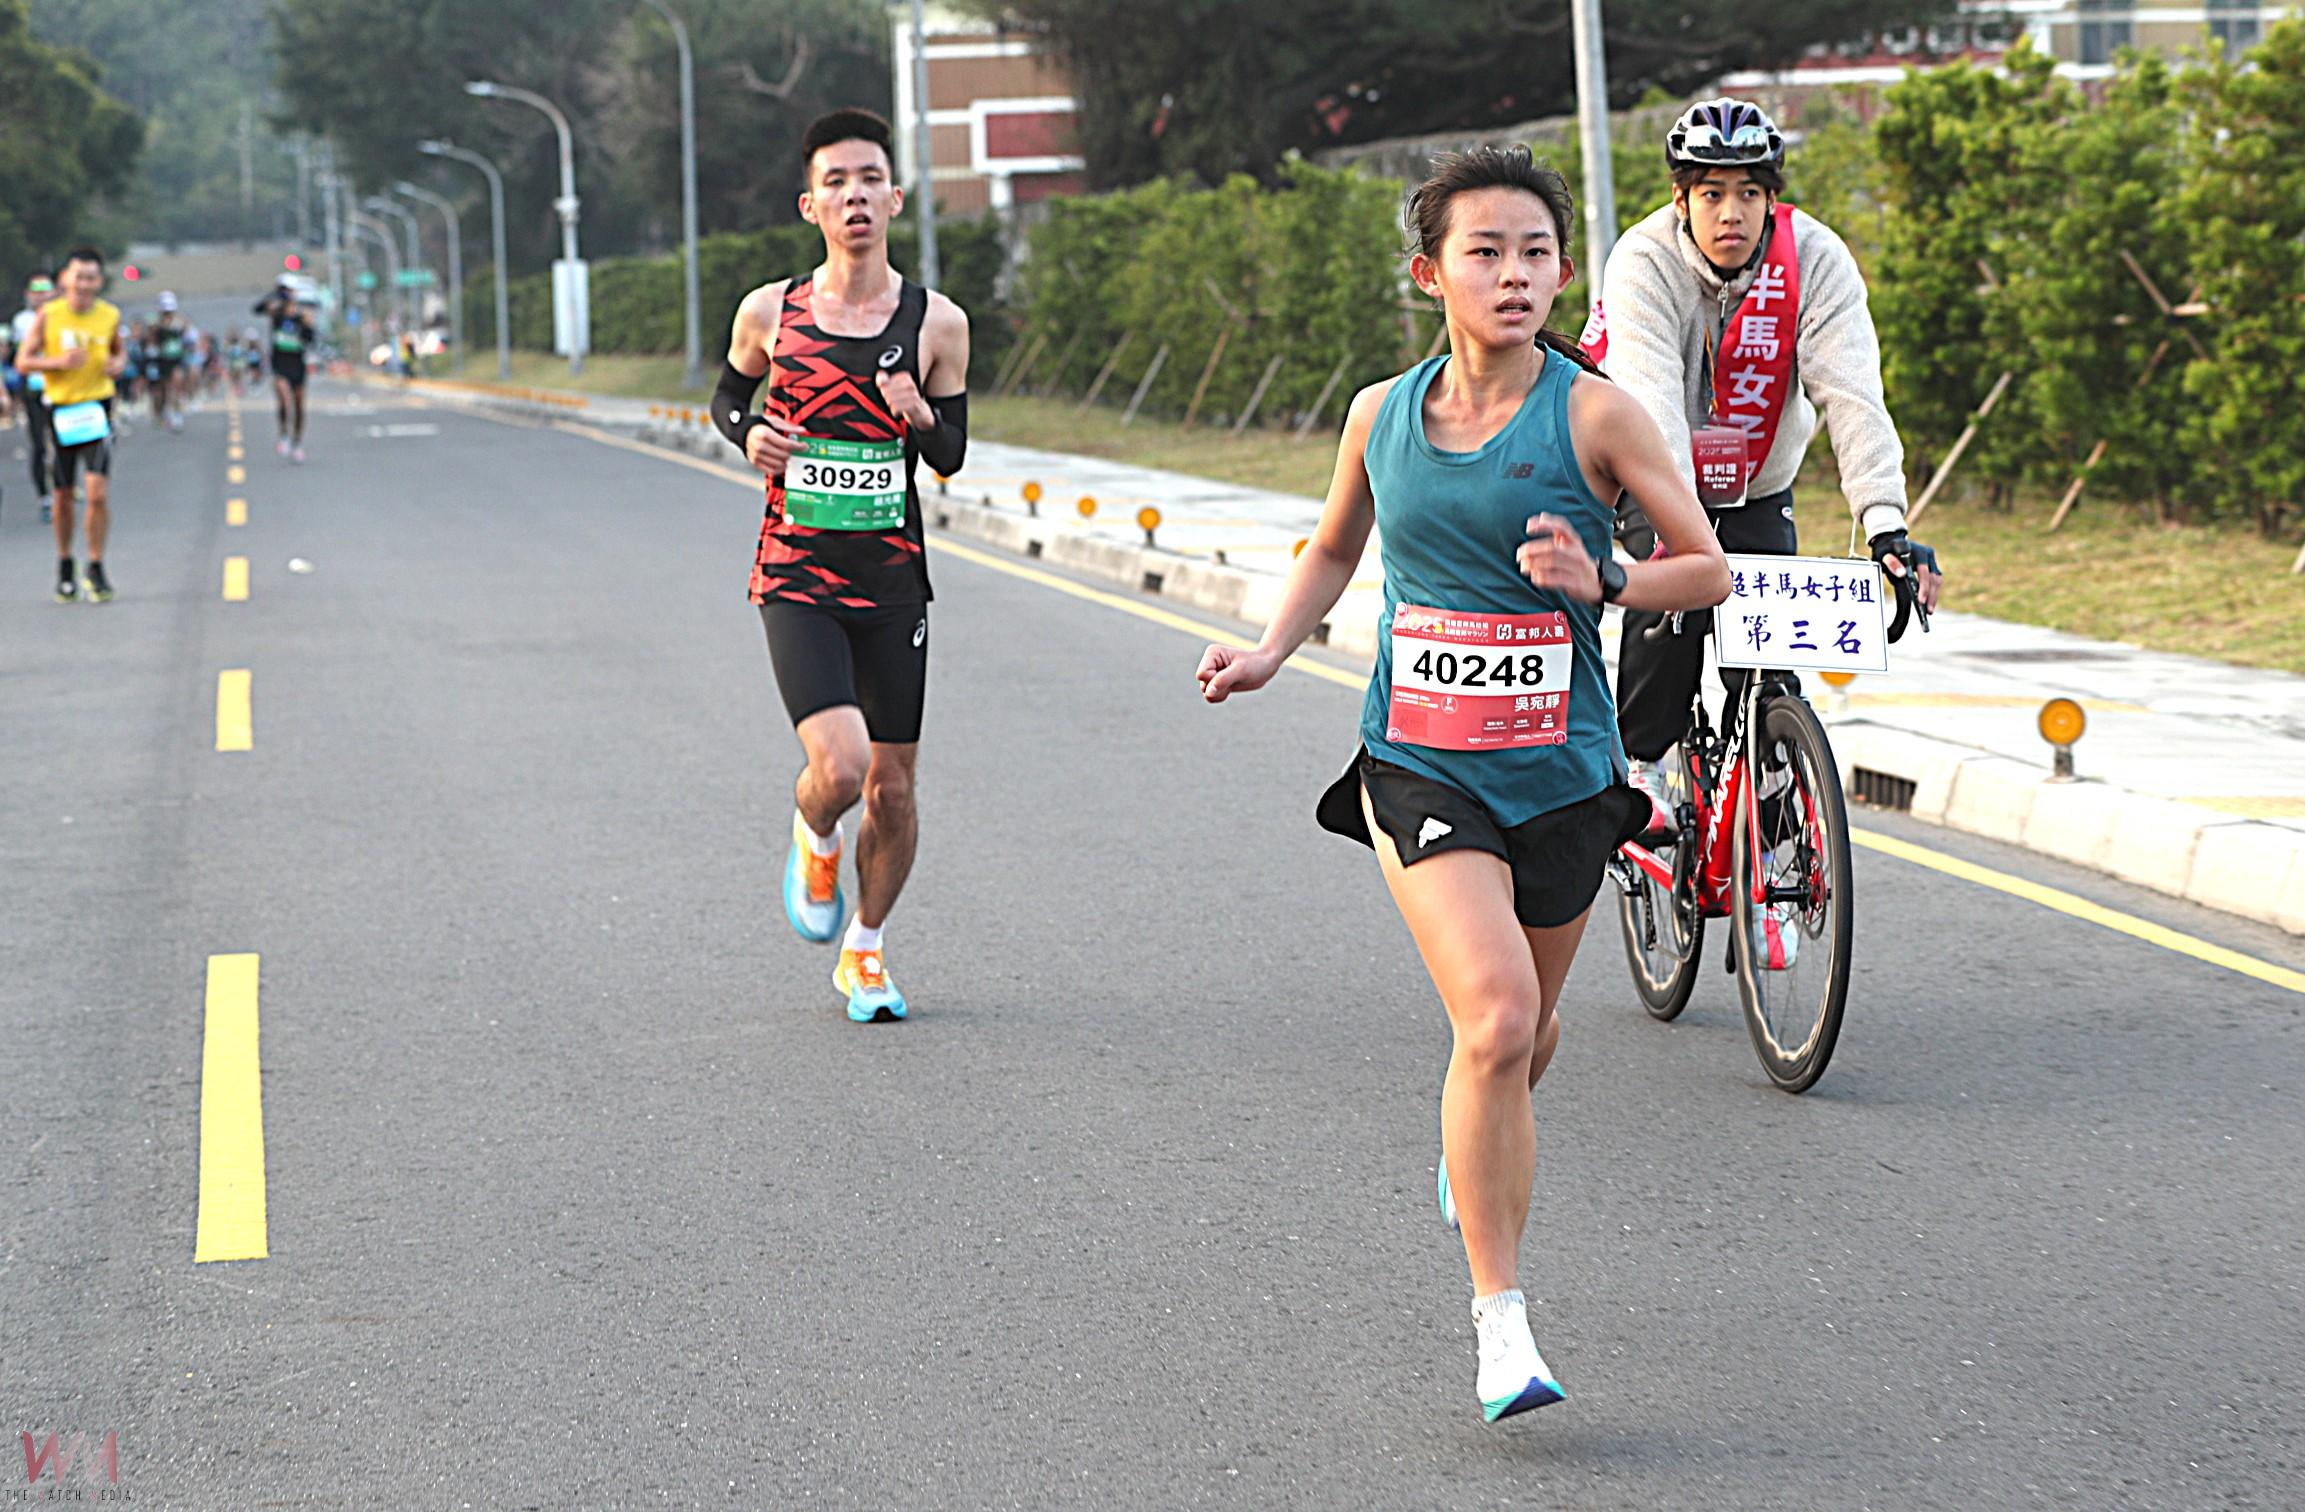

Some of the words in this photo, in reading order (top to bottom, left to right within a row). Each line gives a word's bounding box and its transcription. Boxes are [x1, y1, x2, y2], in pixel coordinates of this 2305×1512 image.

[802, 464, 892, 490] 30929
[1515, 625, 1565, 640] 富邦人壽
[1742, 614, 1862, 655] 第三名
[1412, 649, 1544, 687] 40248
[1705, 699, 1746, 863] PINARELLO
